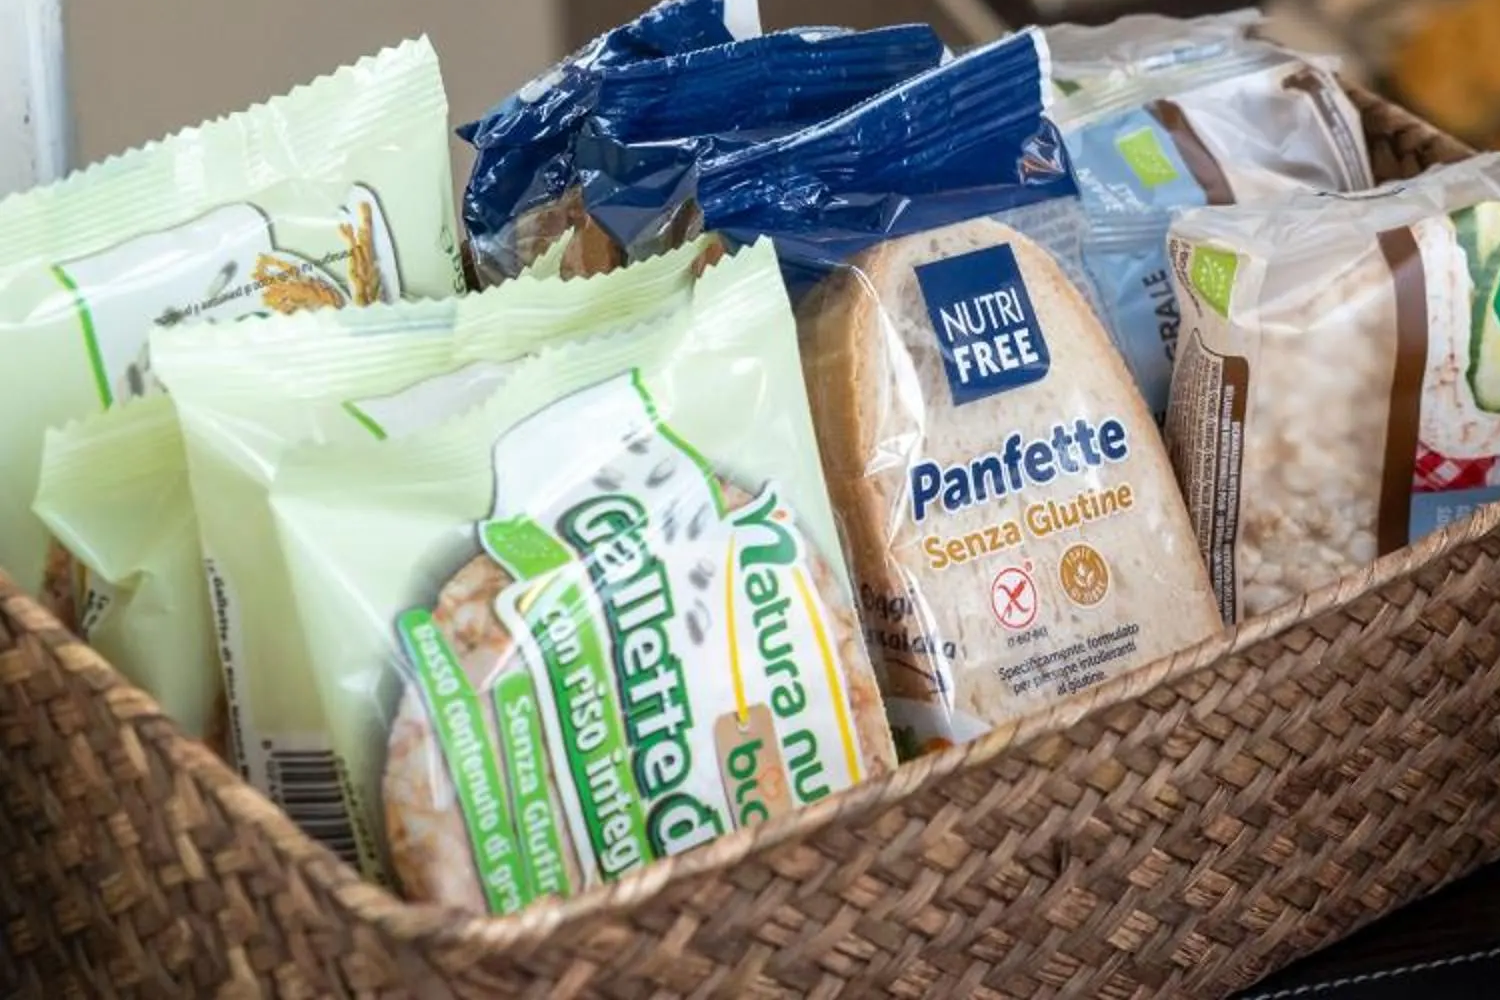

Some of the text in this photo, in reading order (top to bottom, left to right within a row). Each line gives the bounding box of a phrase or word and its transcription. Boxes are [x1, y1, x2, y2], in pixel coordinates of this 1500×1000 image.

[939, 287, 1025, 343] NUTRI
[952, 327, 1040, 384] FREE
[910, 417, 1128, 522] Panfette
[923, 484, 1134, 570] Senza Glutine
[538, 606, 582, 667] con
[563, 663, 608, 752] riso
[564, 496, 691, 793] Gallette
[444, 698, 499, 832] contenuto
[483, 833, 512, 861] di
[505, 695, 540, 796] Senza
